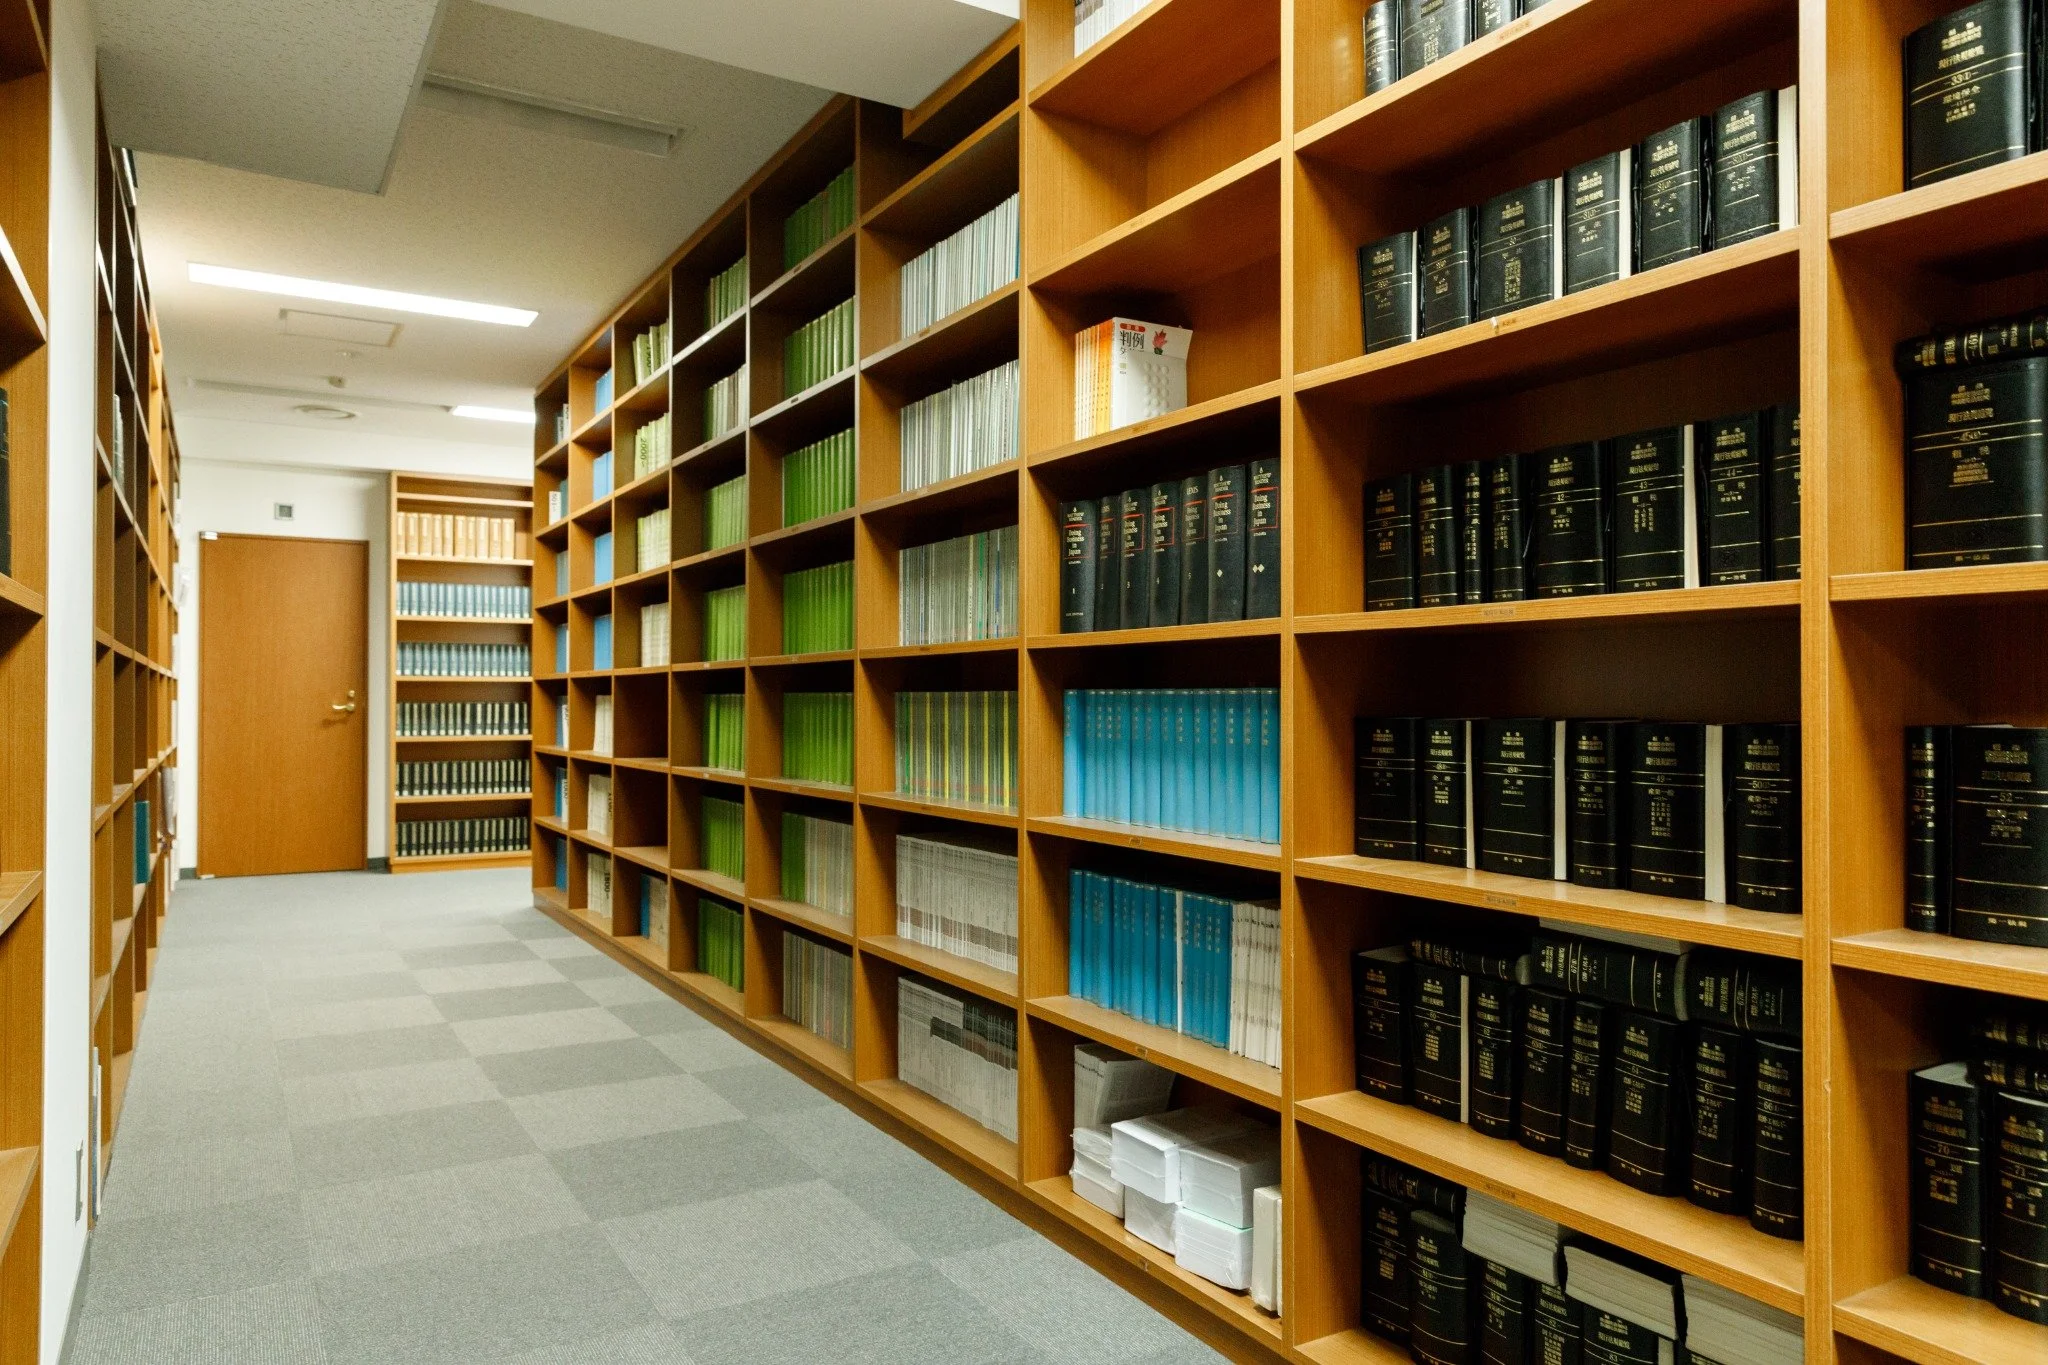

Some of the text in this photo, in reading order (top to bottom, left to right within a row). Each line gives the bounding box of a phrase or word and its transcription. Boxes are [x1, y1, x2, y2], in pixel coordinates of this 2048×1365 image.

[1119, 330, 1145, 349] 判例
[1254, 493, 1269, 503] Doing
[1253, 517, 1267, 527] Japan
